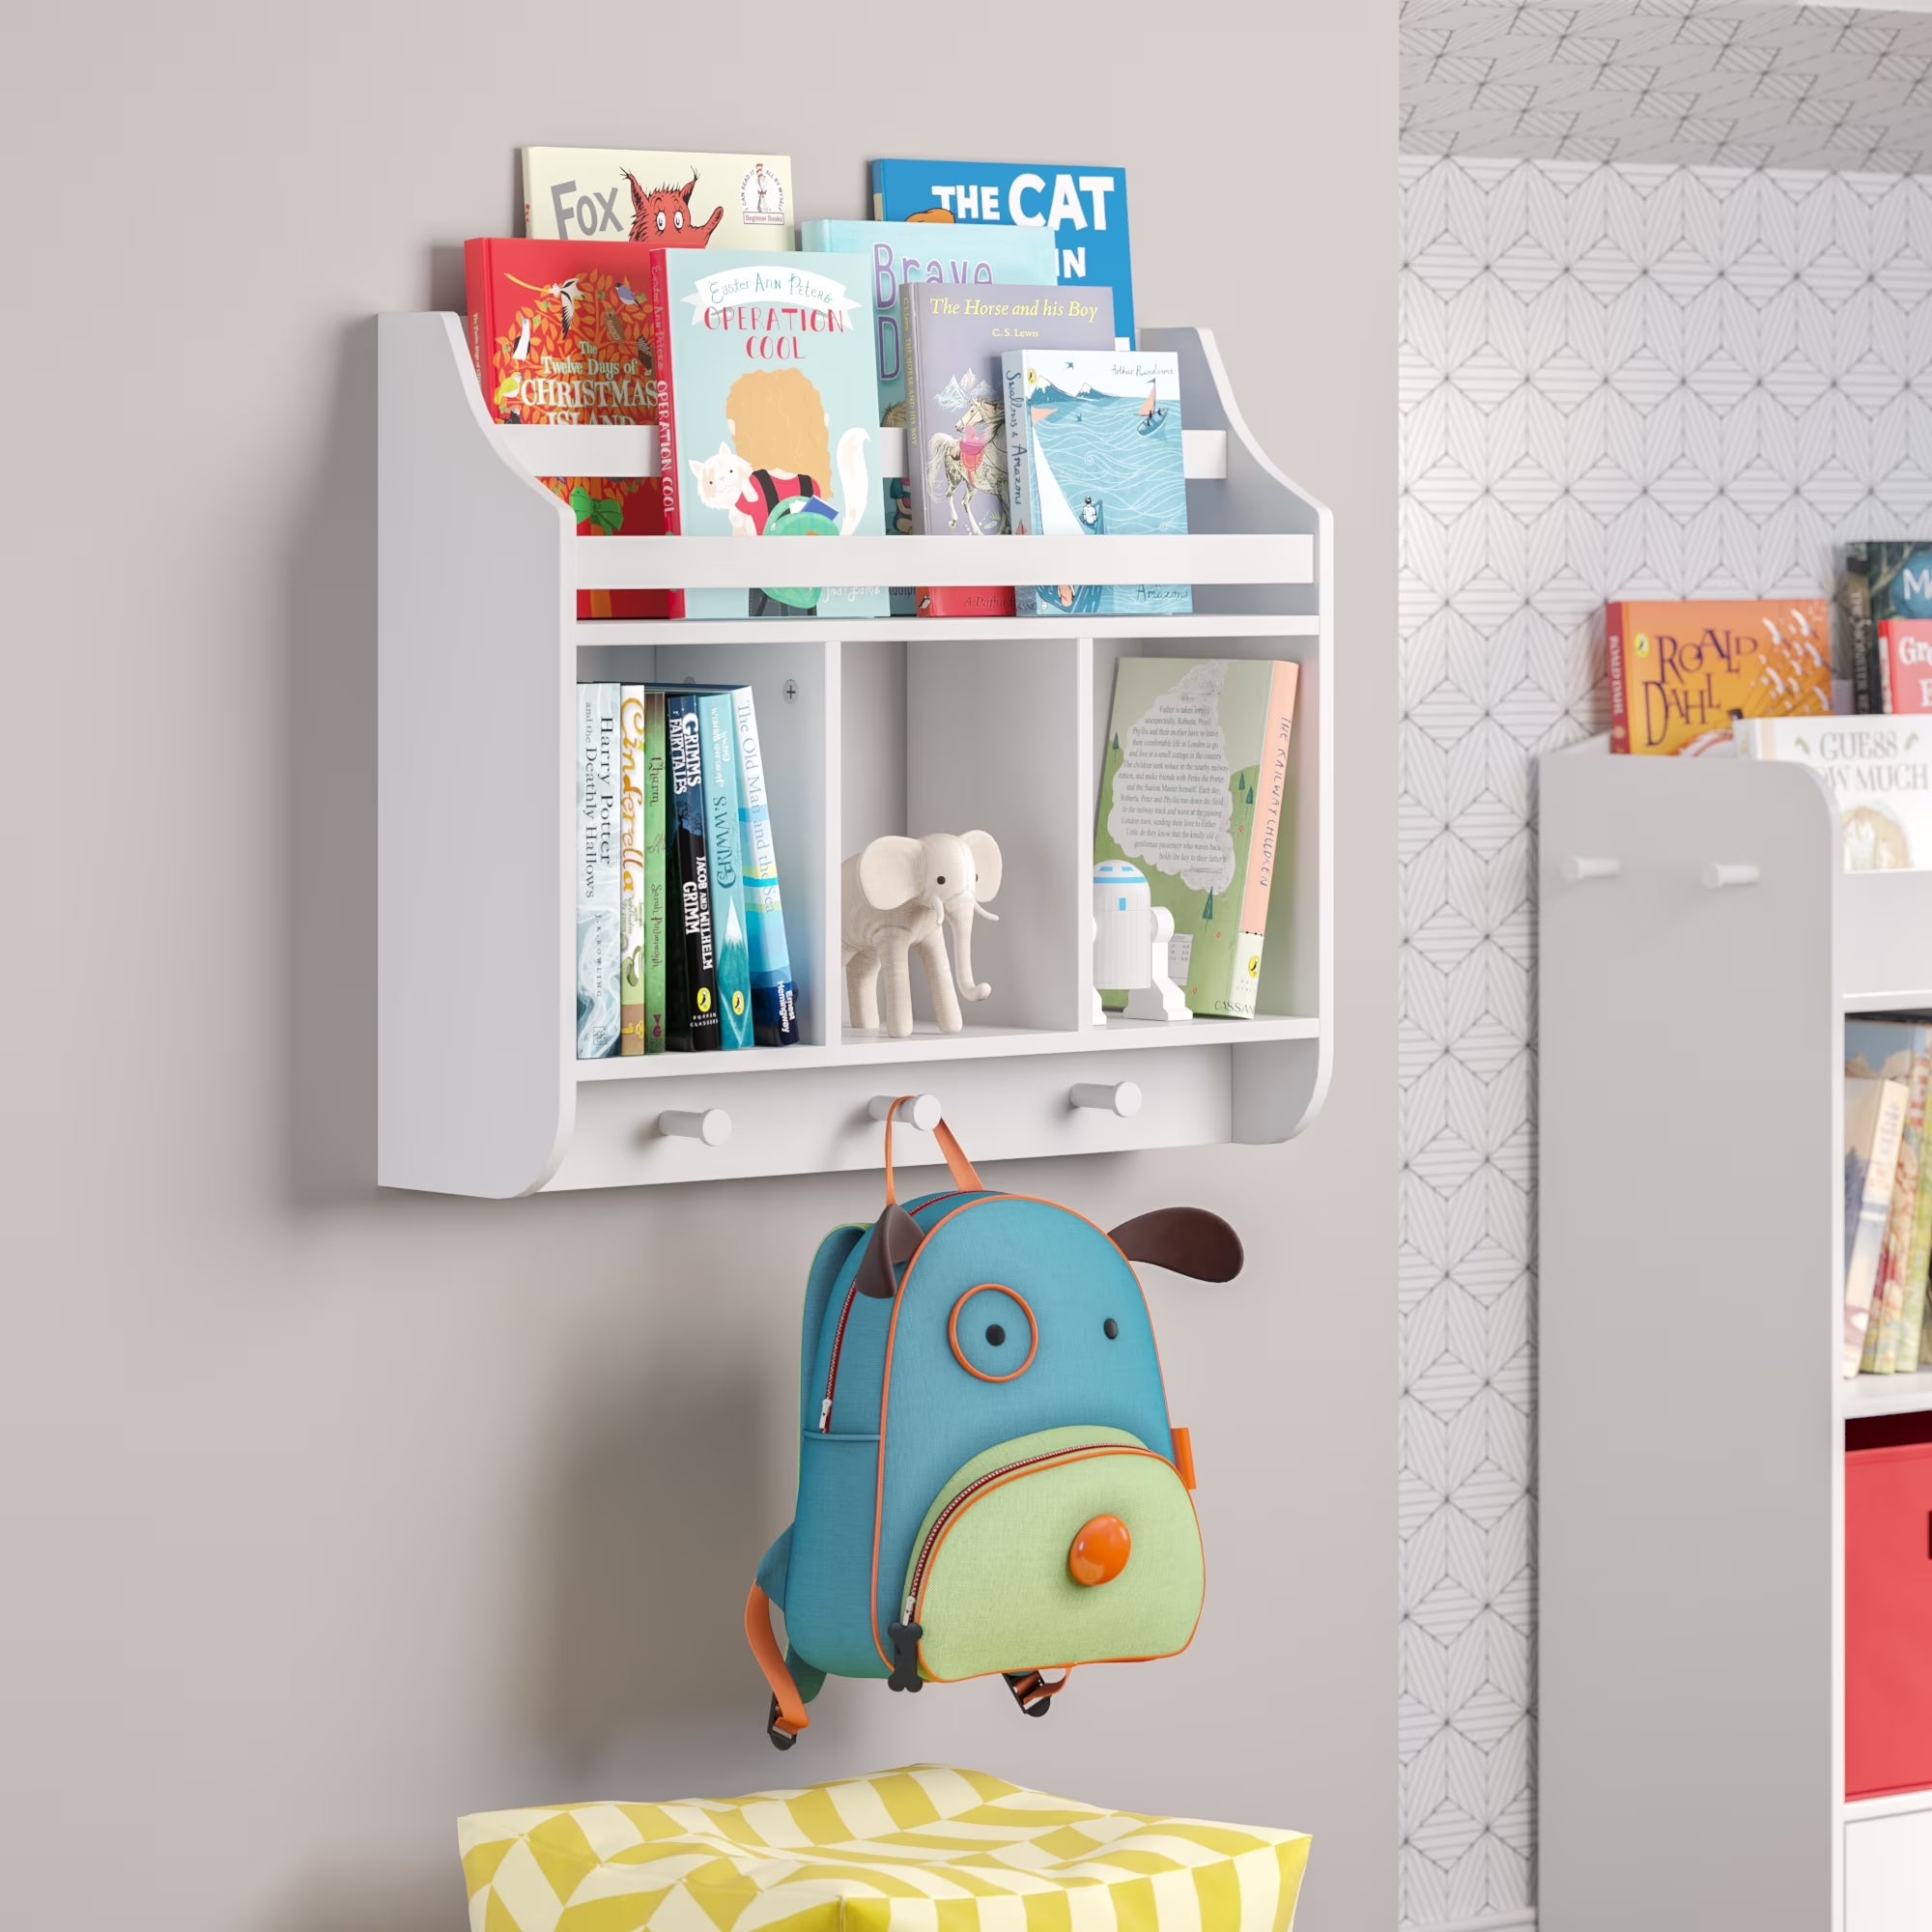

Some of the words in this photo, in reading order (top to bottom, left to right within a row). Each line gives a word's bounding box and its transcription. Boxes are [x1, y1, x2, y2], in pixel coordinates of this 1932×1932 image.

[551, 181, 624, 240] Fox
[745, 214, 767, 223] Beginner
[767, 214, 782, 223] Books
[931, 185, 1001, 220] THE
[1008, 173, 1115, 232] CAT
[708, 278, 751, 304] Easter
[704, 306, 844, 333] OPERATION
[930, 298, 960, 315] The
[964, 298, 1009, 316] Horse
[1012, 299, 1039, 317] and
[1043, 299, 1065, 317] his
[1067, 301, 1098, 324] Boy
[580, 340, 597, 355] The
[746, 335, 807, 360] COOL
[1014, 328, 1039, 338] Lewis
[541, 355, 583, 375] Twelve
[587, 358, 620, 381] Days
[623, 358, 638, 375] of
[521, 378, 659, 409] CHRISTMAS
[1007, 370, 1024, 428] Swallows
[657, 381, 672, 472] OPERATION
[1011, 443, 1028, 505] Amazons
[662, 476, 675, 518] COOL
[976, 596, 1006, 611] Puffin
[1136, 584, 1188, 602] Amazons
[1656, 628, 1758, 686] ROALD
[737, 699, 752, 733] The
[1643, 673, 1720, 747] DAHL
[1279, 716, 1293, 741] THE
[598, 717, 614, 787] Harry
[682, 713, 702, 787] GRIMMS
[741, 738, 758, 771] Old
[1820, 731, 1899, 761] GUESS
[583, 747, 598, 819] Deathly
[648, 756, 665, 809] Charm
[1267, 748, 1287, 817] RAILWAY
[1855, 763, 1929, 792] MUCH
[620, 697, 645, 892] Cinderella
[747, 776, 761, 814] Man
[600, 795, 614, 865] Potter
[712, 796, 736, 889] GRIMM'S
[752, 821, 769, 851] and
[585, 827, 598, 898] Hallows
[759, 856, 774, 881] the
[1260, 819, 1276, 887] CHILDREN
[696, 856, 708, 889] JACOB
[651, 884, 663, 914] Sarah
[683, 882, 700, 935] GRIMM
[699, 892, 708, 911] AND
[763, 886, 776, 914] Sea
[651, 918, 663, 970] Pinborough
[700, 912, 713, 970] WILHELM
[693, 1012, 718, 1021] PUFFIN
[777, 980, 790, 1034] Hemingway
[785, 989, 796, 1020] Ernest
[690, 1018, 719, 1028] CLASSICS
